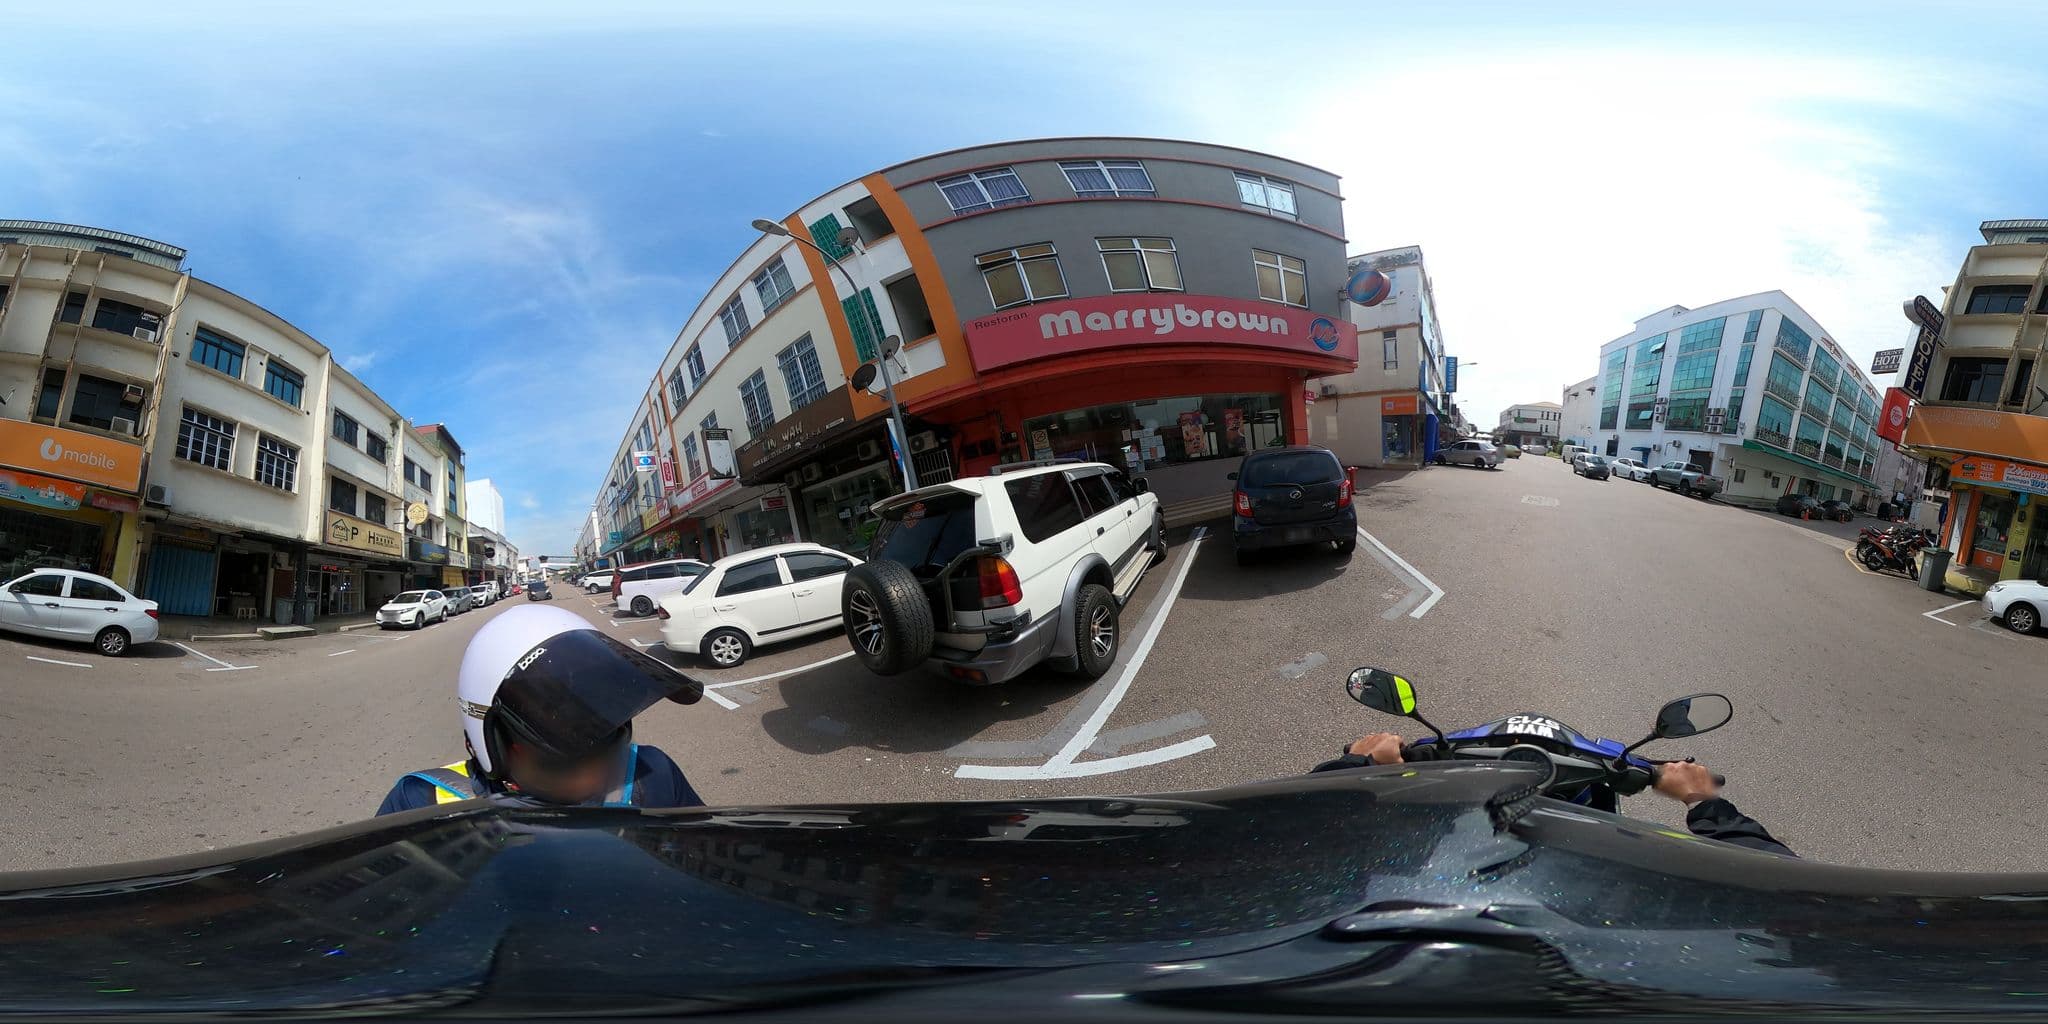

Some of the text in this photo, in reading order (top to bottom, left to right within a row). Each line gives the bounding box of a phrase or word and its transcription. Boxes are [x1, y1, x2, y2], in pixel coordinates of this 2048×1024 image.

[974, 311, 1027, 330] Restoran
[1038, 303, 1289, 339] Marrybrown
[1908, 323, 1938, 395] HOTEL
[64, 450, 117, 470] mobile
[1507, 723, 1554, 738] WYM
